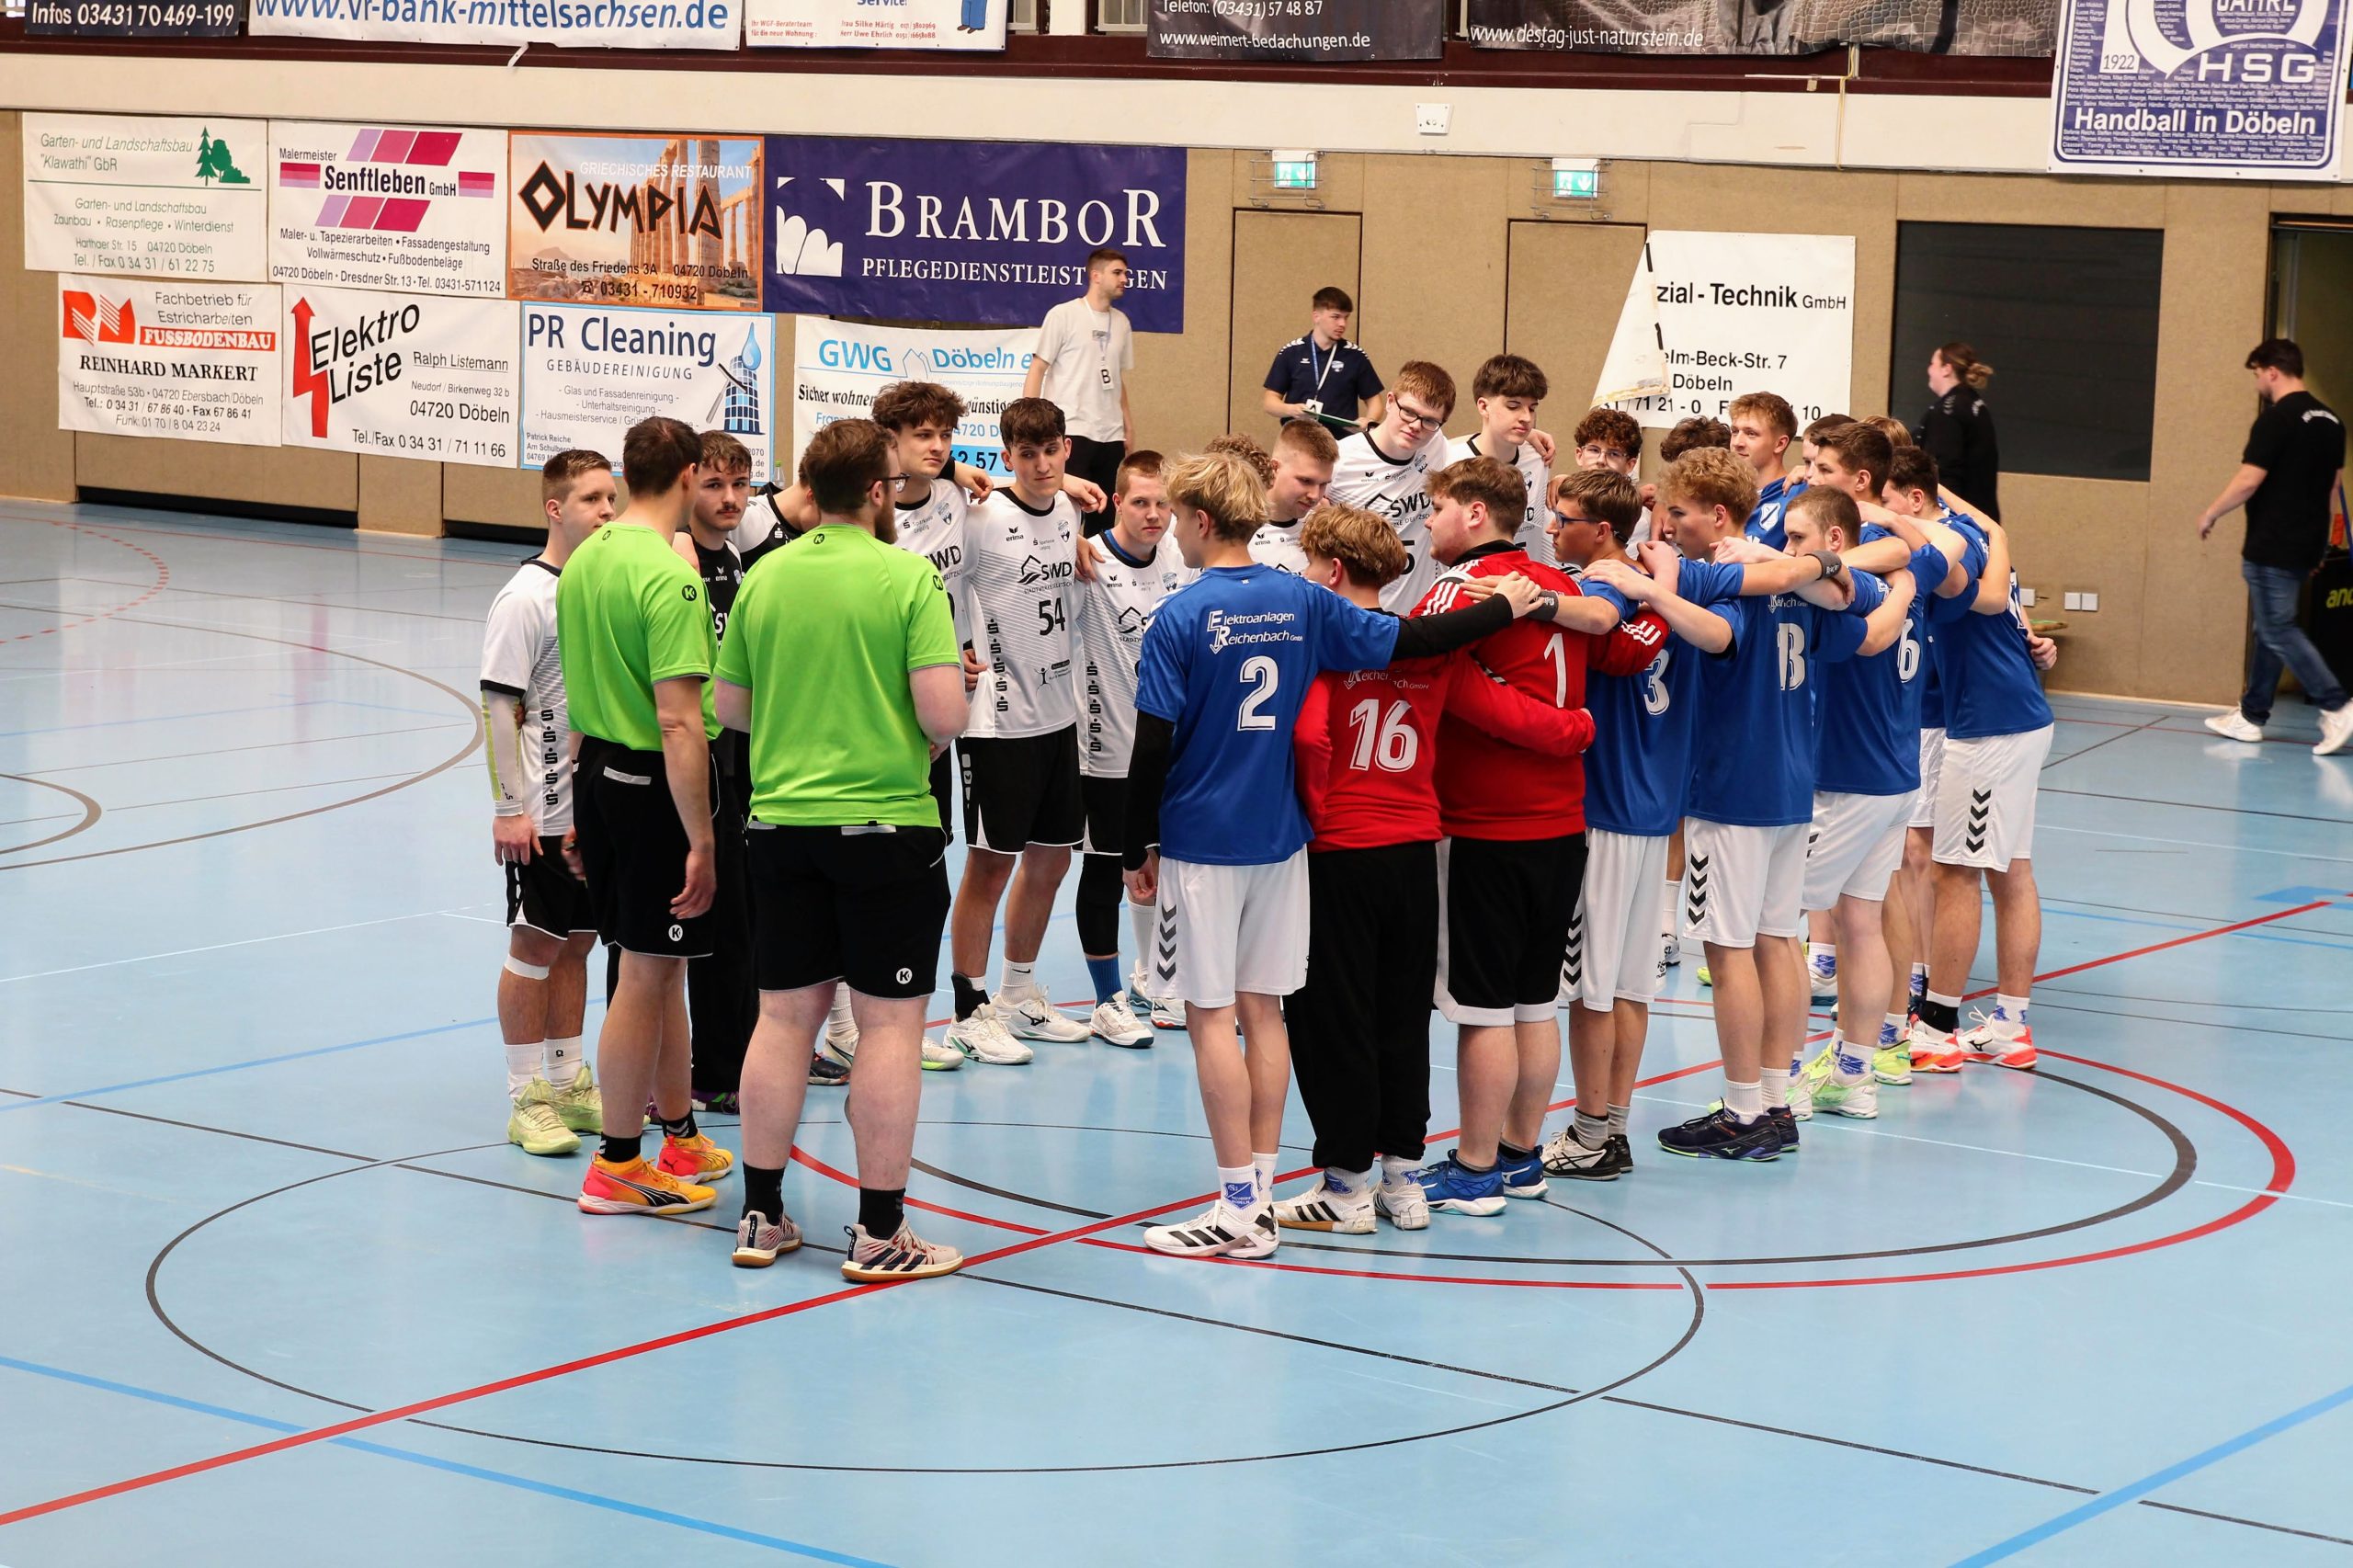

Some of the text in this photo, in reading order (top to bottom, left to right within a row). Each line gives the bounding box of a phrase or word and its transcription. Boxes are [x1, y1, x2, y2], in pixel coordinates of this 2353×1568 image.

[32, 5, 234, 27] Infos 03431 70 469-199
[1212, 0, 1266, 19] (03431)
[1268, 2, 1282, 17] 57
[1286, 2, 1302, 16] 48
[1305, 1, 1323, 15] 87
[785, 30, 813, 39] Wohnung
[1159, 31, 1371, 51] www.weimert-bedachungen.de
[1471, 22, 1703, 50] www.destag-just-naturstein.de
[2103, 54, 2135, 70] 1922
[2198, 52, 2317, 84] HSG
[2075, 107, 2316, 135] Handball in Döbeln
[41, 133, 192, 153] Garten- und Landschaftsbau
[94, 157, 118, 172] GbR
[279, 148, 336, 162] Malermeister
[324, 165, 457, 197] Senftleben GmbH
[580, 162, 752, 179] GRIECHISCHES RESTAURANT
[75, 198, 207, 214] Garten- und Landschaftsbau
[517, 160, 722, 240] OLYMPIA
[54, 214, 234, 233] Zaunbau Rasenpflege Winterdienst
[864, 180, 1167, 248] BRAMBOR
[112, 240, 123, 251] Str.
[127, 240, 137, 252] 15
[147, 242, 176, 253] 04720
[178, 242, 213, 254] Döbeln
[280, 228, 490, 255] Maler- u. Tapezierarbeiten Fassadengestaltung
[74, 254, 214, 273] Tel. Fax 34 31 61 22 75
[307, 247, 463, 268] Vollwärmeschutz Fußbodenbeläge
[532, 257, 749, 279] Straße des Friedens 3A 04720 Döbeln
[273, 266, 501, 292] 04720 Döbeln Dresdner Str. 13 Tel. 03431-571124
[862, 257, 1167, 291] PFLEGEDIENSTLEISTGEN
[155, 291, 252, 306] Fachbetrieb für
[600, 281, 697, 300] 03431 710932
[1710, 283, 1798, 308] Technik
[1802, 295, 1847, 309] GmbH
[158, 311, 253, 325] Estricharbeiten
[143, 328, 272, 349] FUSSBODENBAU
[312, 303, 420, 370] Elektro
[529, 313, 716, 367] PR Cleaning
[413, 351, 508, 371] Ralph Listemann
[819, 338, 1015, 372] GWG Döbeln
[1778, 355, 1787, 369] 7
[79, 355, 258, 381] REINHARD MARKERT
[329, 351, 402, 404] Liste
[547, 358, 692, 380] GEBÄUDEREINIGUNG
[73, 381, 263, 405] Hauptstraße 53b 04720 Ebersbach/Döbeln
[411, 381, 503, 398] Neudorf Birkenweg 32
[1673, 373, 1733, 392] Döbeln
[563, 385, 674, 403] Glas und Fassadenreinigung
[799, 384, 829, 403] Sicher
[85, 397, 251, 418] Tel.: 34 31 67 86 40 Fax 67 86 41
[410, 400, 509, 424] 04720 Döbeln
[540, 410, 618, 425] Hausmeisterservice
[582, 400, 655, 415] Unterhaltsreinigung
[1635, 396, 1651, 410] 71
[1658, 397, 1673, 412] 21
[1802, 405, 1822, 421] 10
[116, 415, 221, 432] Funk: 01 70 04 23 24
[352, 429, 506, 457] Tel./Fax 0 34 31 71 11 66
[527, 433, 571, 443] Patrick Reiche
[1006, 533, 1024, 541] erima
[1040, 562, 1072, 581] SWD
[1038, 597, 1066, 636] 54
[1207, 610, 1294, 631] Elektroanlagen
[1215, 625, 1290, 647] Reichenbach
[1543, 631, 1567, 709] 1
[1236, 654, 1279, 732] 2
[1348, 698, 1419, 773] 16
